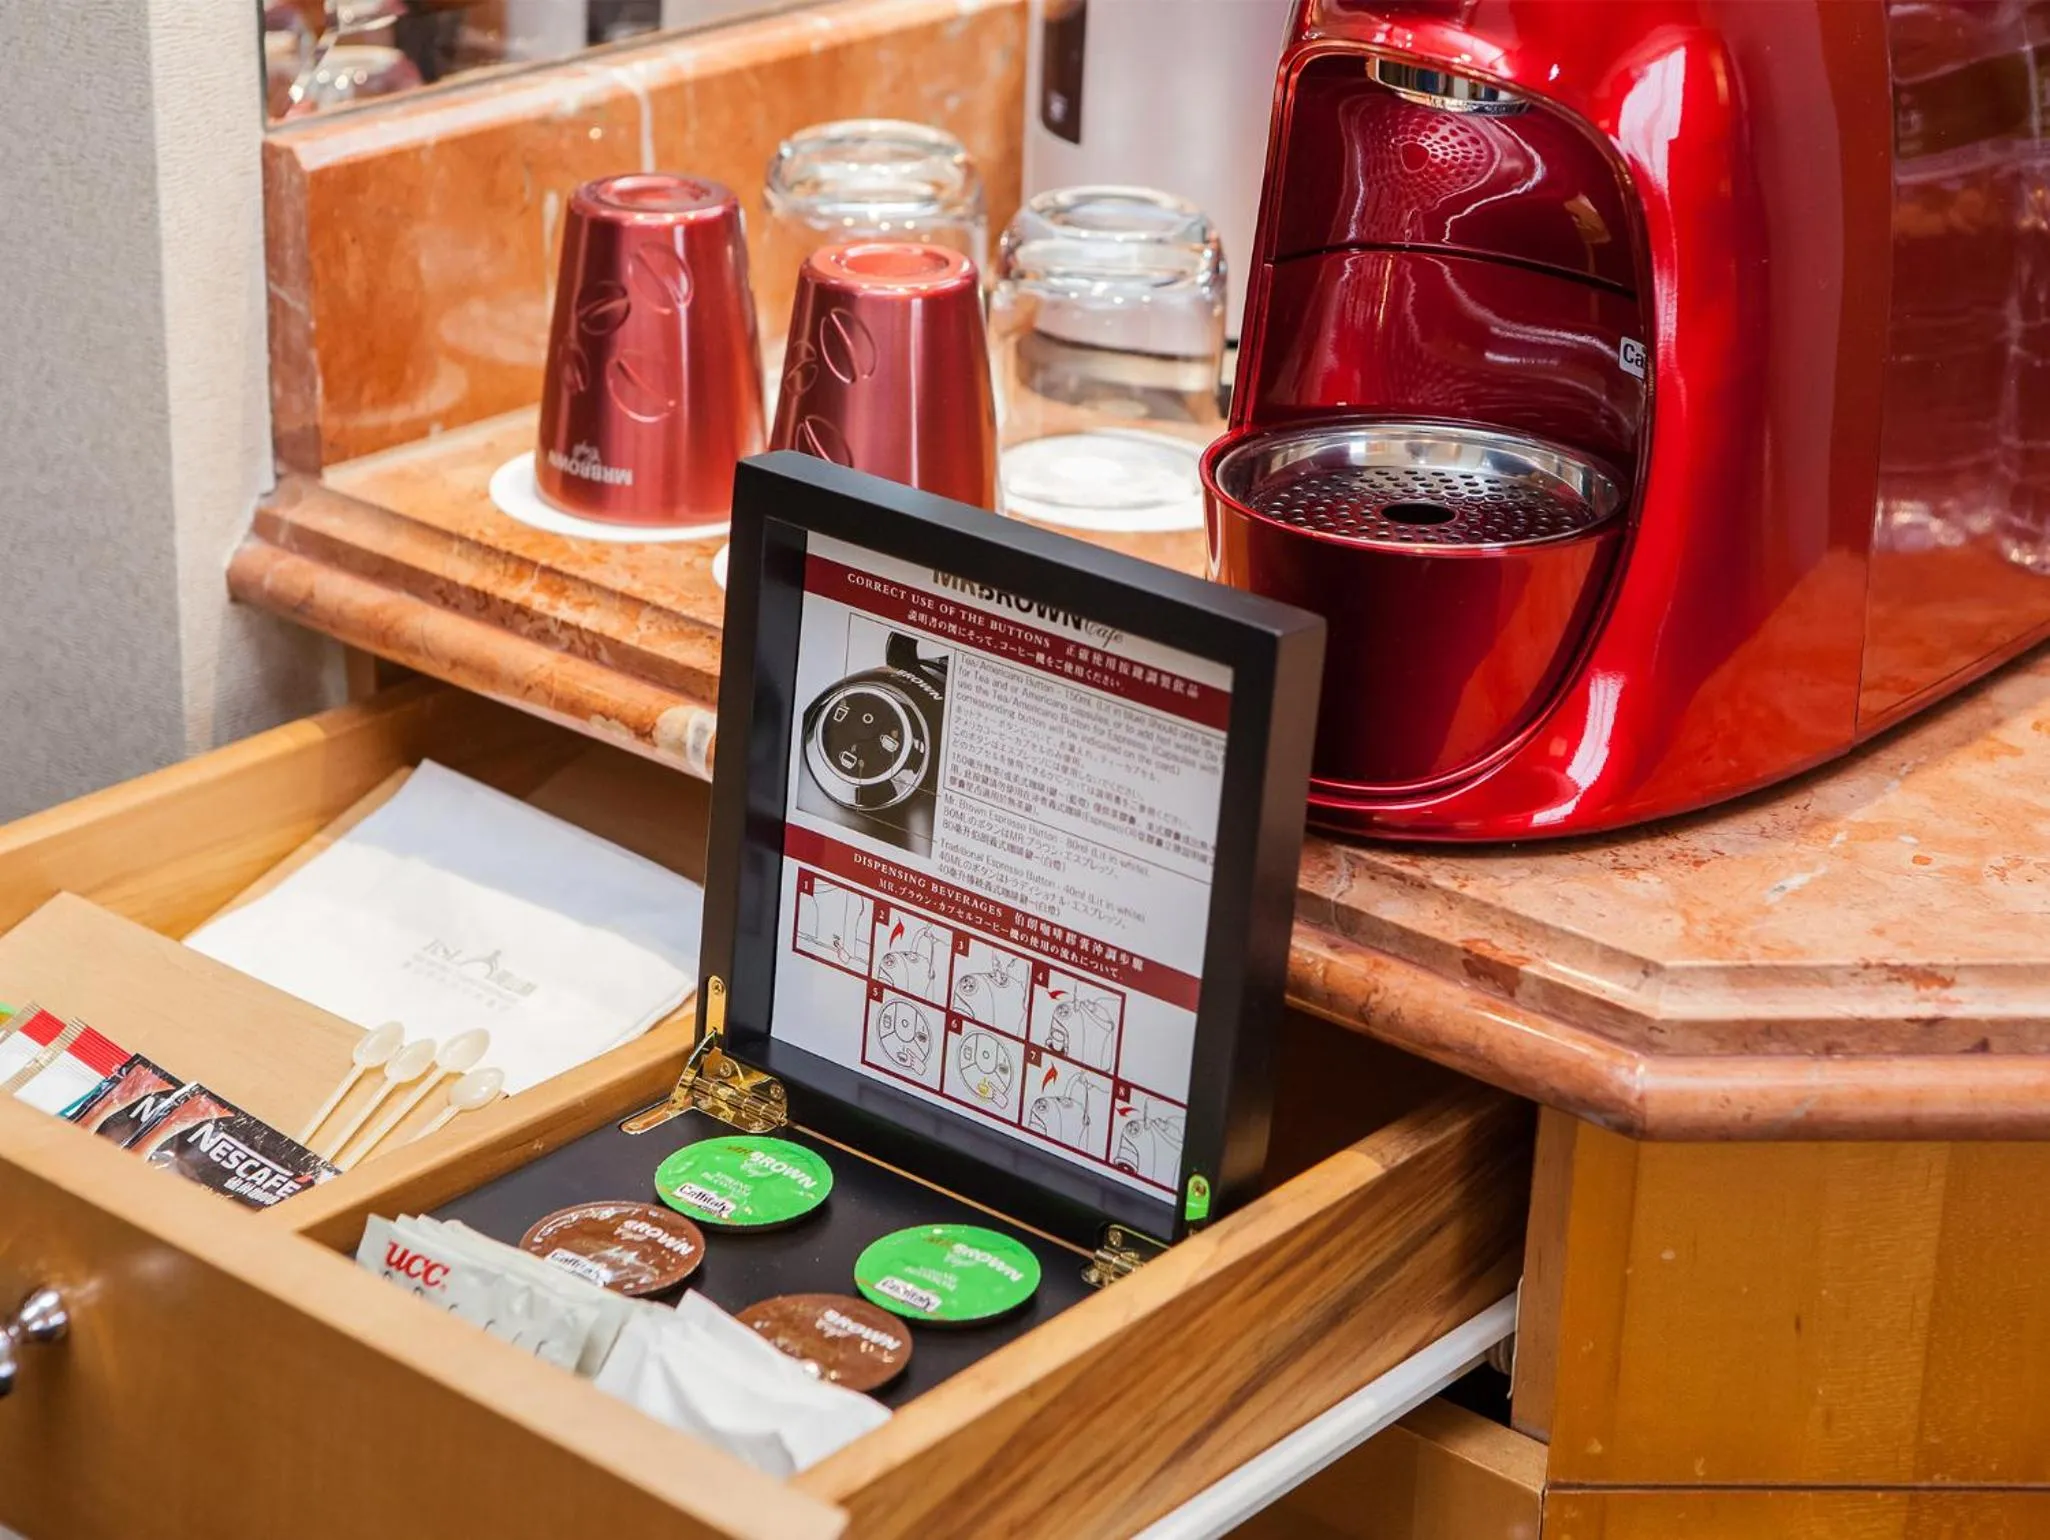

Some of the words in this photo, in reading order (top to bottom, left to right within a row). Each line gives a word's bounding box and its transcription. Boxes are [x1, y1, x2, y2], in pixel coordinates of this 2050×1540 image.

[1622, 343, 1647, 369] Ca
[847, 572, 906, 601] CORRECT
[911, 593, 934, 610] USE
[938, 602, 955, 617] OF
[959, 609, 984, 627] THE
[989, 619, 1050, 648] BUTTONS
[853, 852, 926, 888] DISPENSING
[931, 881, 1002, 918] BEVERAGES
